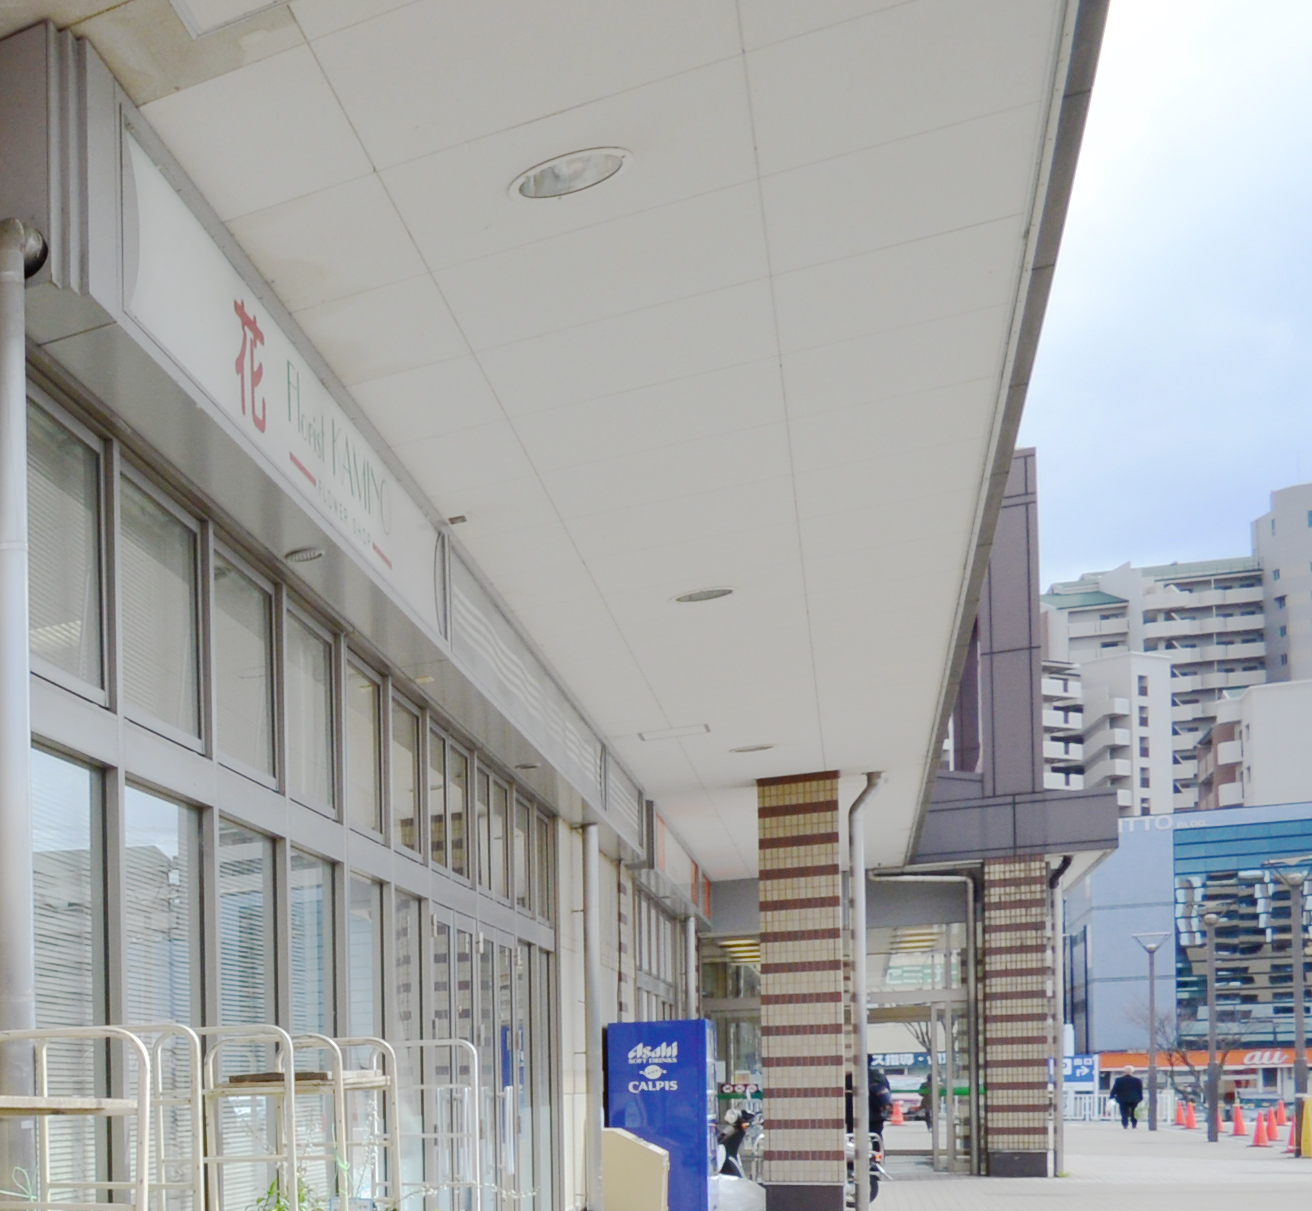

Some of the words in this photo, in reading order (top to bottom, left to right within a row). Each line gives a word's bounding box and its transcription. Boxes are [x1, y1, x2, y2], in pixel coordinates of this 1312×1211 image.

[233, 297, 266, 434] 花
[286, 358, 324, 462] Florist
[331, 418, 391, 536] KAMINO
[628, 1041, 678, 1058] Asahi
[1243, 1050, 1288, 1065] au
[628, 1080, 678, 1093] CALPIS
